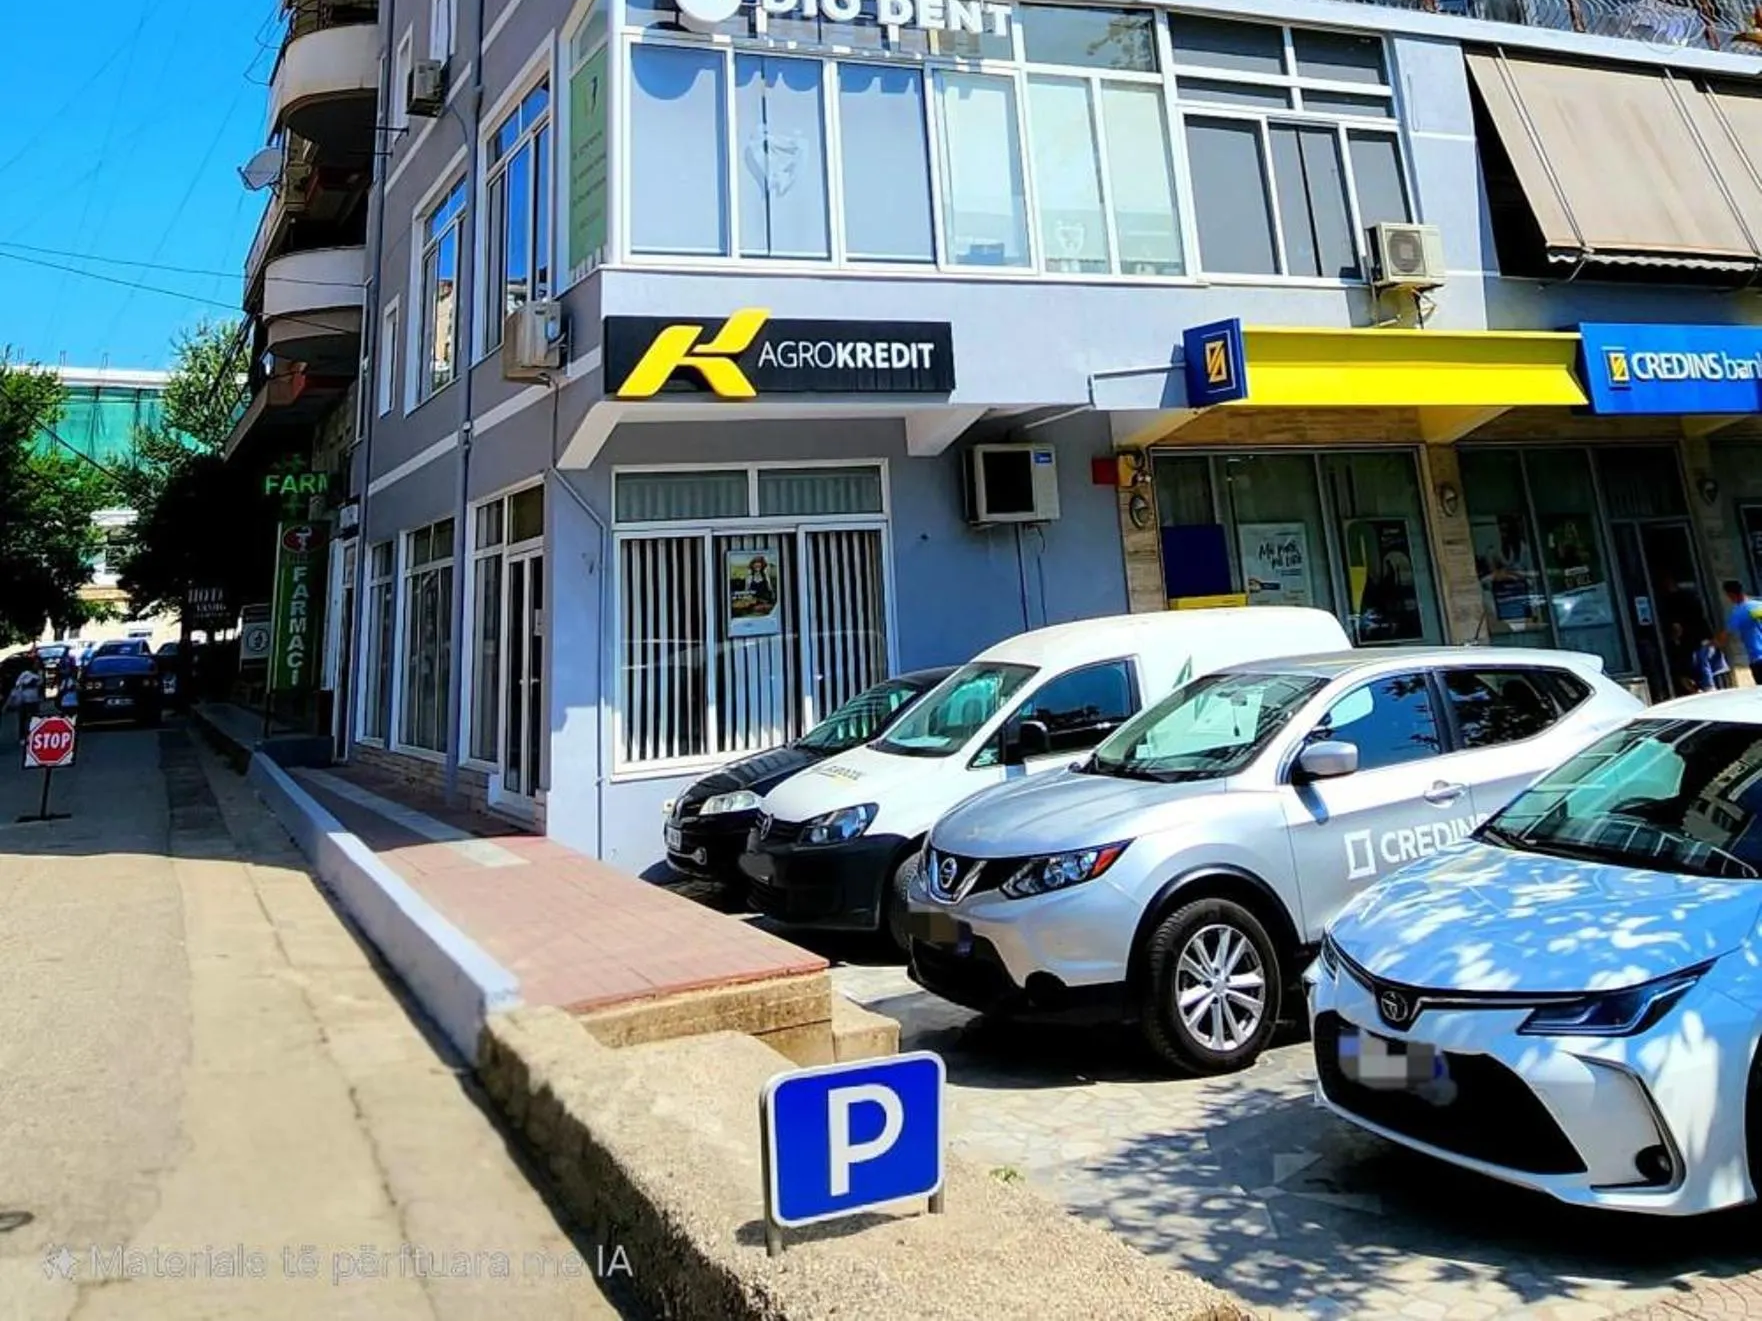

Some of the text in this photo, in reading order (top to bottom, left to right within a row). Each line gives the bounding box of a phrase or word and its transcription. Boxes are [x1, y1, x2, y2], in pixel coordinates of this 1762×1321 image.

[758, 340, 935, 370] AGROKREDIT
[1631, 351, 1724, 380] CREDINS
[286, 565, 310, 687] FARMACI
[34, 732, 71, 749] STOP
[828, 1083, 905, 1197] P
